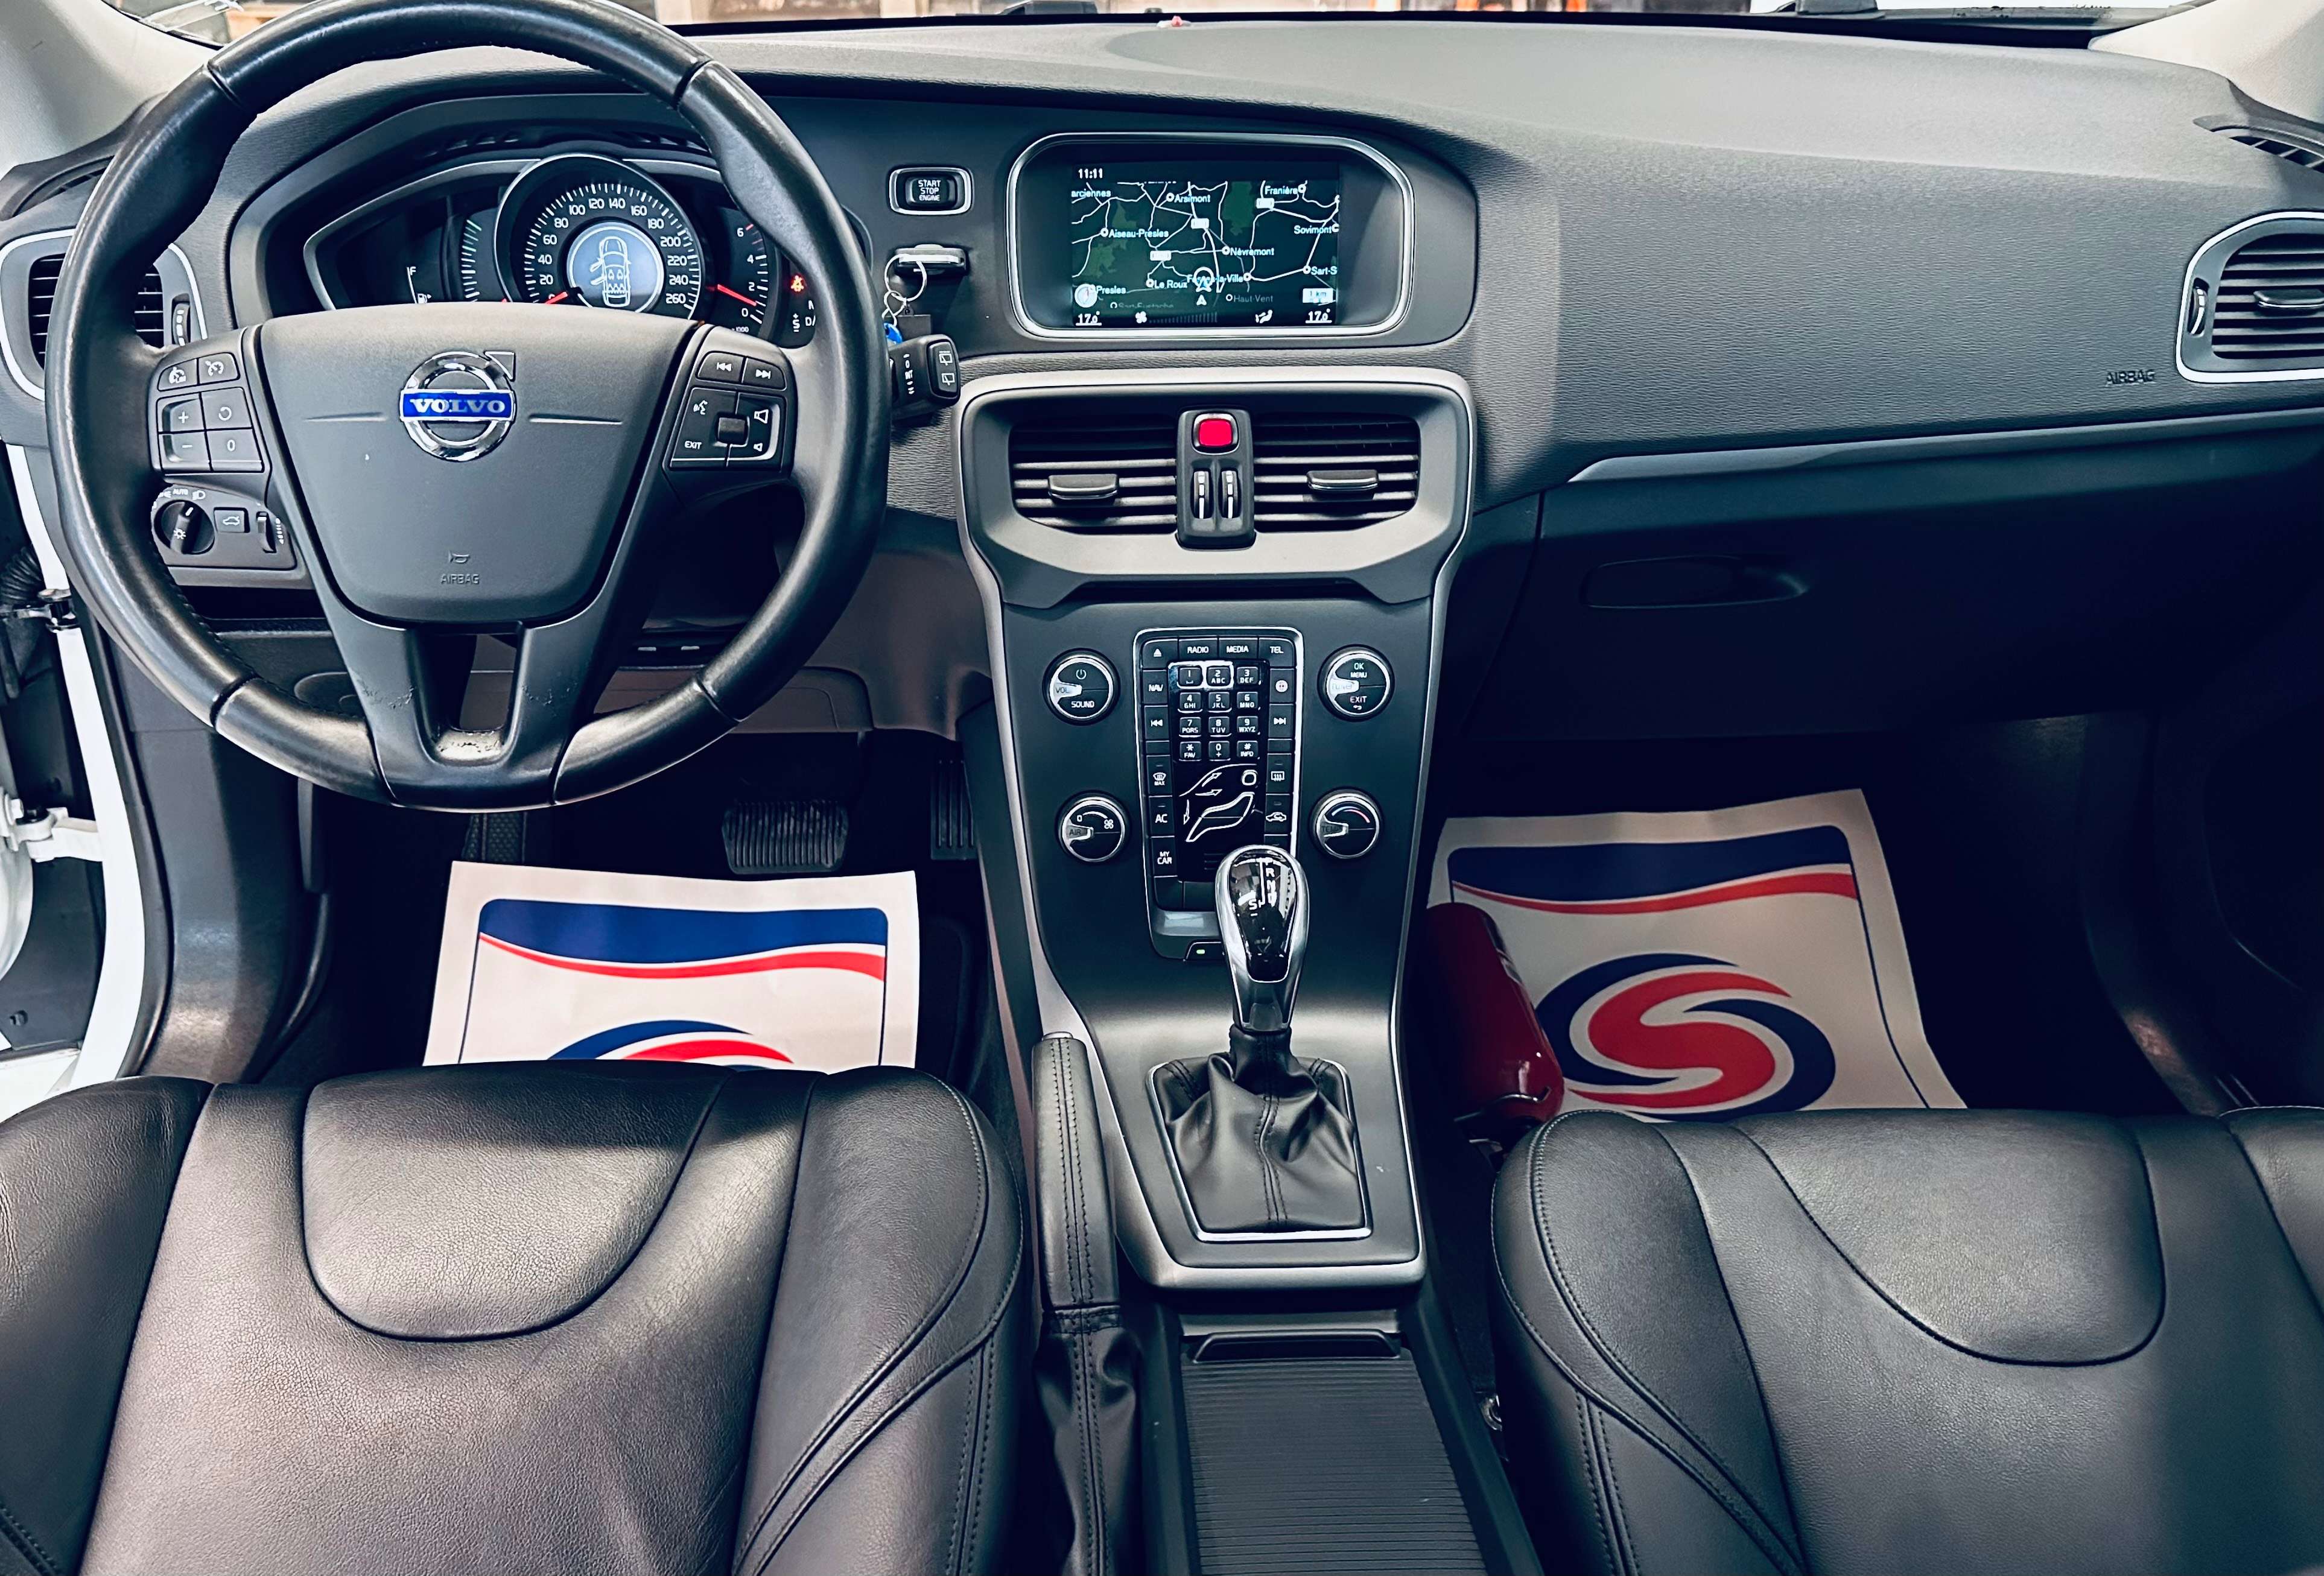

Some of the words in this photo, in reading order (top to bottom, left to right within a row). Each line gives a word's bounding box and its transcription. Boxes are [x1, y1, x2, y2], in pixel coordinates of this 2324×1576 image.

[1078, 168, 1103, 179] 11:11
[589, 198, 605, 209] 120
[609, 198, 626, 209] 140
[1174, 194, 1211, 203] Arsimont
[569, 204, 586, 216] 100
[631, 205, 647, 217] 160
[554, 217, 569, 229] 80
[648, 218, 664, 229] 180
[737, 227, 744, 237] 6
[1108, 228, 1169, 238] Aiseau-Presles
[1294, 224, 1332, 235] Sovimont
[543, 234, 557, 245] 60
[660, 236, 681, 247] 200
[538, 254, 553, 265] 40
[667, 255, 688, 266] 220
[747, 254, 754, 264] 4
[410, 266, 416, 276] F
[539, 274, 553, 285] 20
[669, 274, 688, 285] 240
[1155, 280, 1165, 289] Le
[1167, 279, 1188, 288] Roux
[748, 282, 755, 291] 2
[1096, 285, 1126, 294] Presles
[665, 293, 686, 304] 260
[741, 308, 749, 317] 0
[2106, 369, 2156, 385] AIRBAG
[410, 397, 506, 414] VOLVO
[684, 440, 702, 450] EXIT
[440, 574, 480, 585] AIRBAG
[1056, 685, 1068, 694] VOL
[1149, 684, 1164, 692] NAV
[1216, 743, 1222, 752] 0
[1155, 814, 1168, 823] AC
[1248, 899, 1258, 910] S
